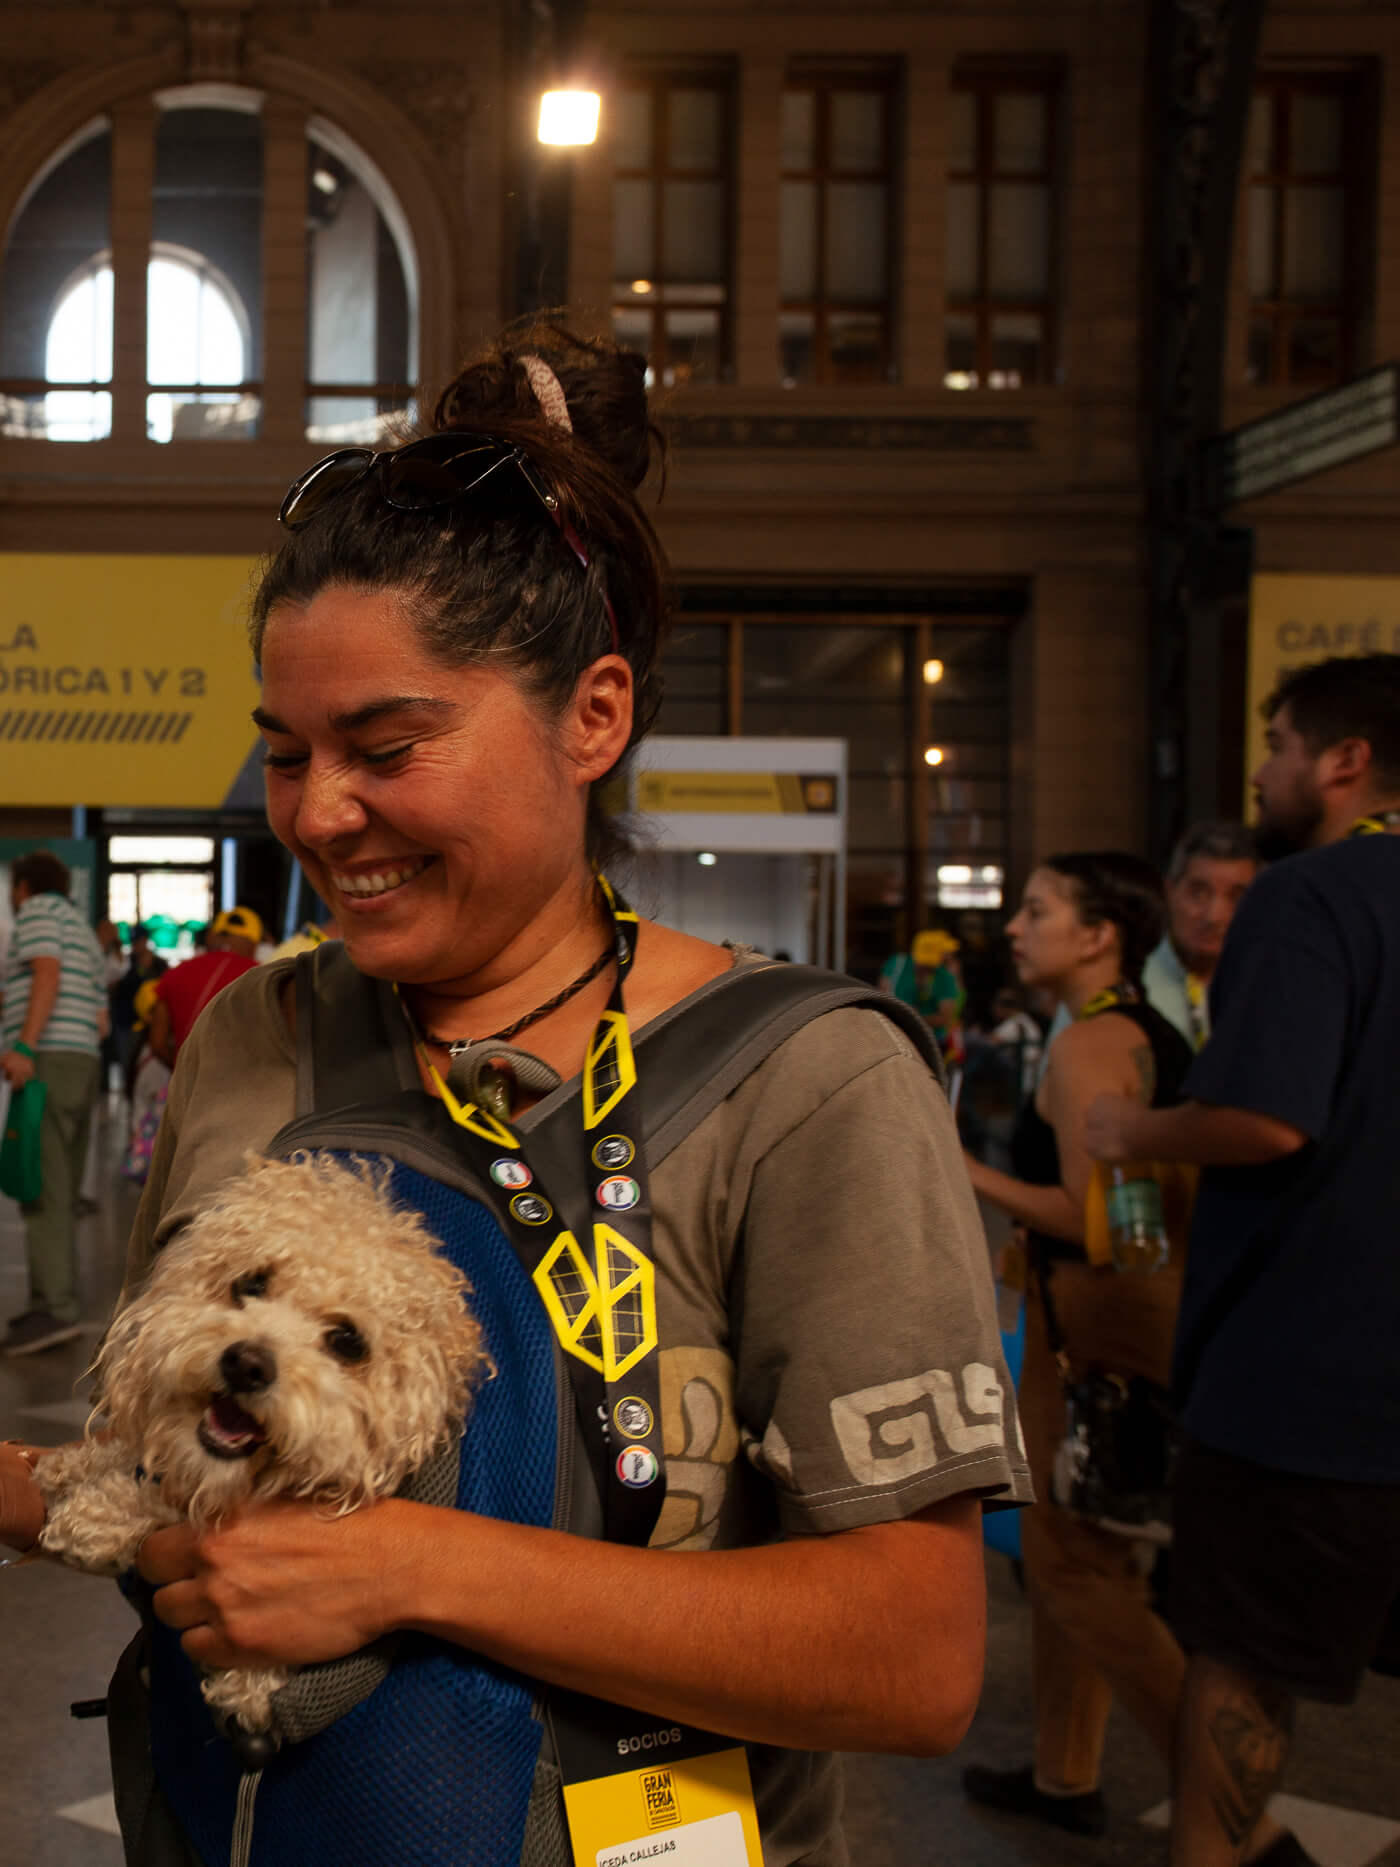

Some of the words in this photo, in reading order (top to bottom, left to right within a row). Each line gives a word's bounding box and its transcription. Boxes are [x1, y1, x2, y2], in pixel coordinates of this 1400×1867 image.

[1276, 617, 1380, 652] CAFÉ
[119, 669, 132, 694] 1
[144, 668, 168, 695] Y
[180, 668, 206, 696] 2
[617, 1727, 681, 1755] SOCIOS
[643, 1772, 671, 1793] GRAN
[647, 1790, 674, 1810] FERIA
[630, 1840, 676, 1862] CALLEJAS
